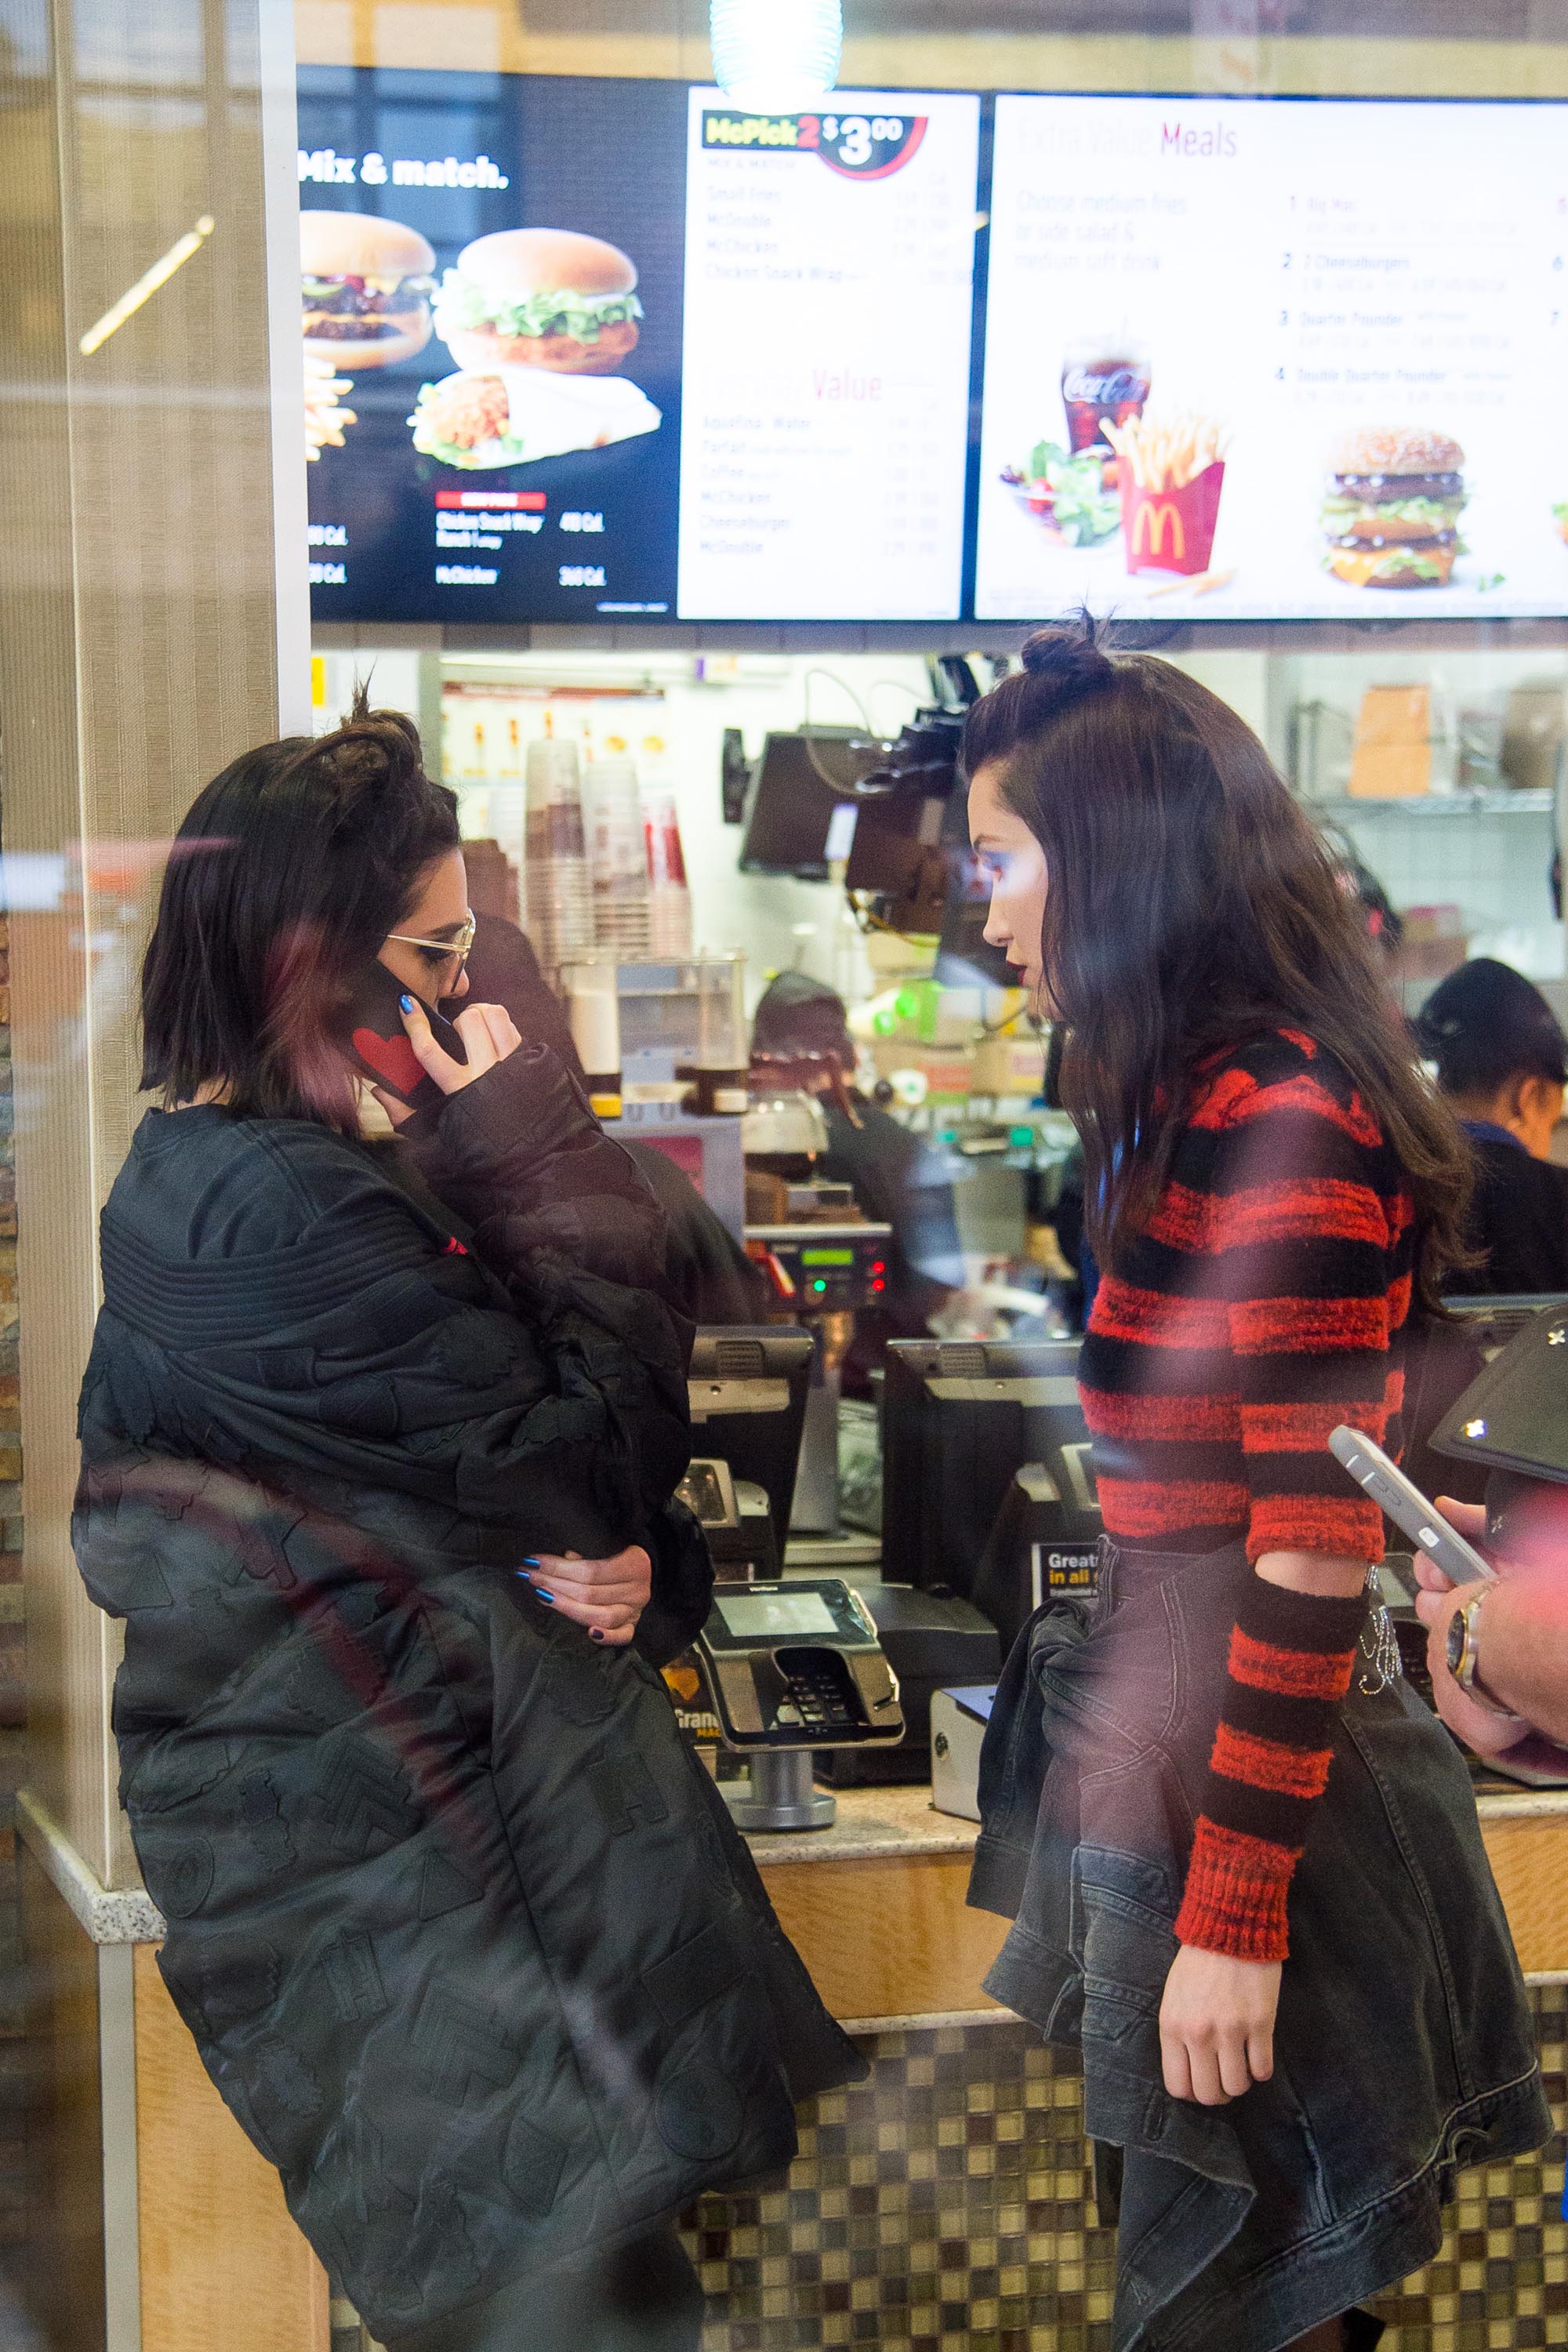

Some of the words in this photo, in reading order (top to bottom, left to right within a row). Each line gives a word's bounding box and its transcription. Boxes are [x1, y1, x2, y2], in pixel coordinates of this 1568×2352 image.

[706, 117, 795, 147] McPick
[1159, 121, 1239, 157] Meals
[298, 148, 356, 183] Mix
[361, 152, 388, 184] &
[393, 155, 509, 189] match.
[1281, 250, 1293, 269] 2
[1279, 308, 1290, 327] 3
[811, 367, 883, 401] Value
[1275, 365, 1287, 382] 4
[1049, 1569, 1065, 1584] in
[1069, 1569, 1089, 1584] all
